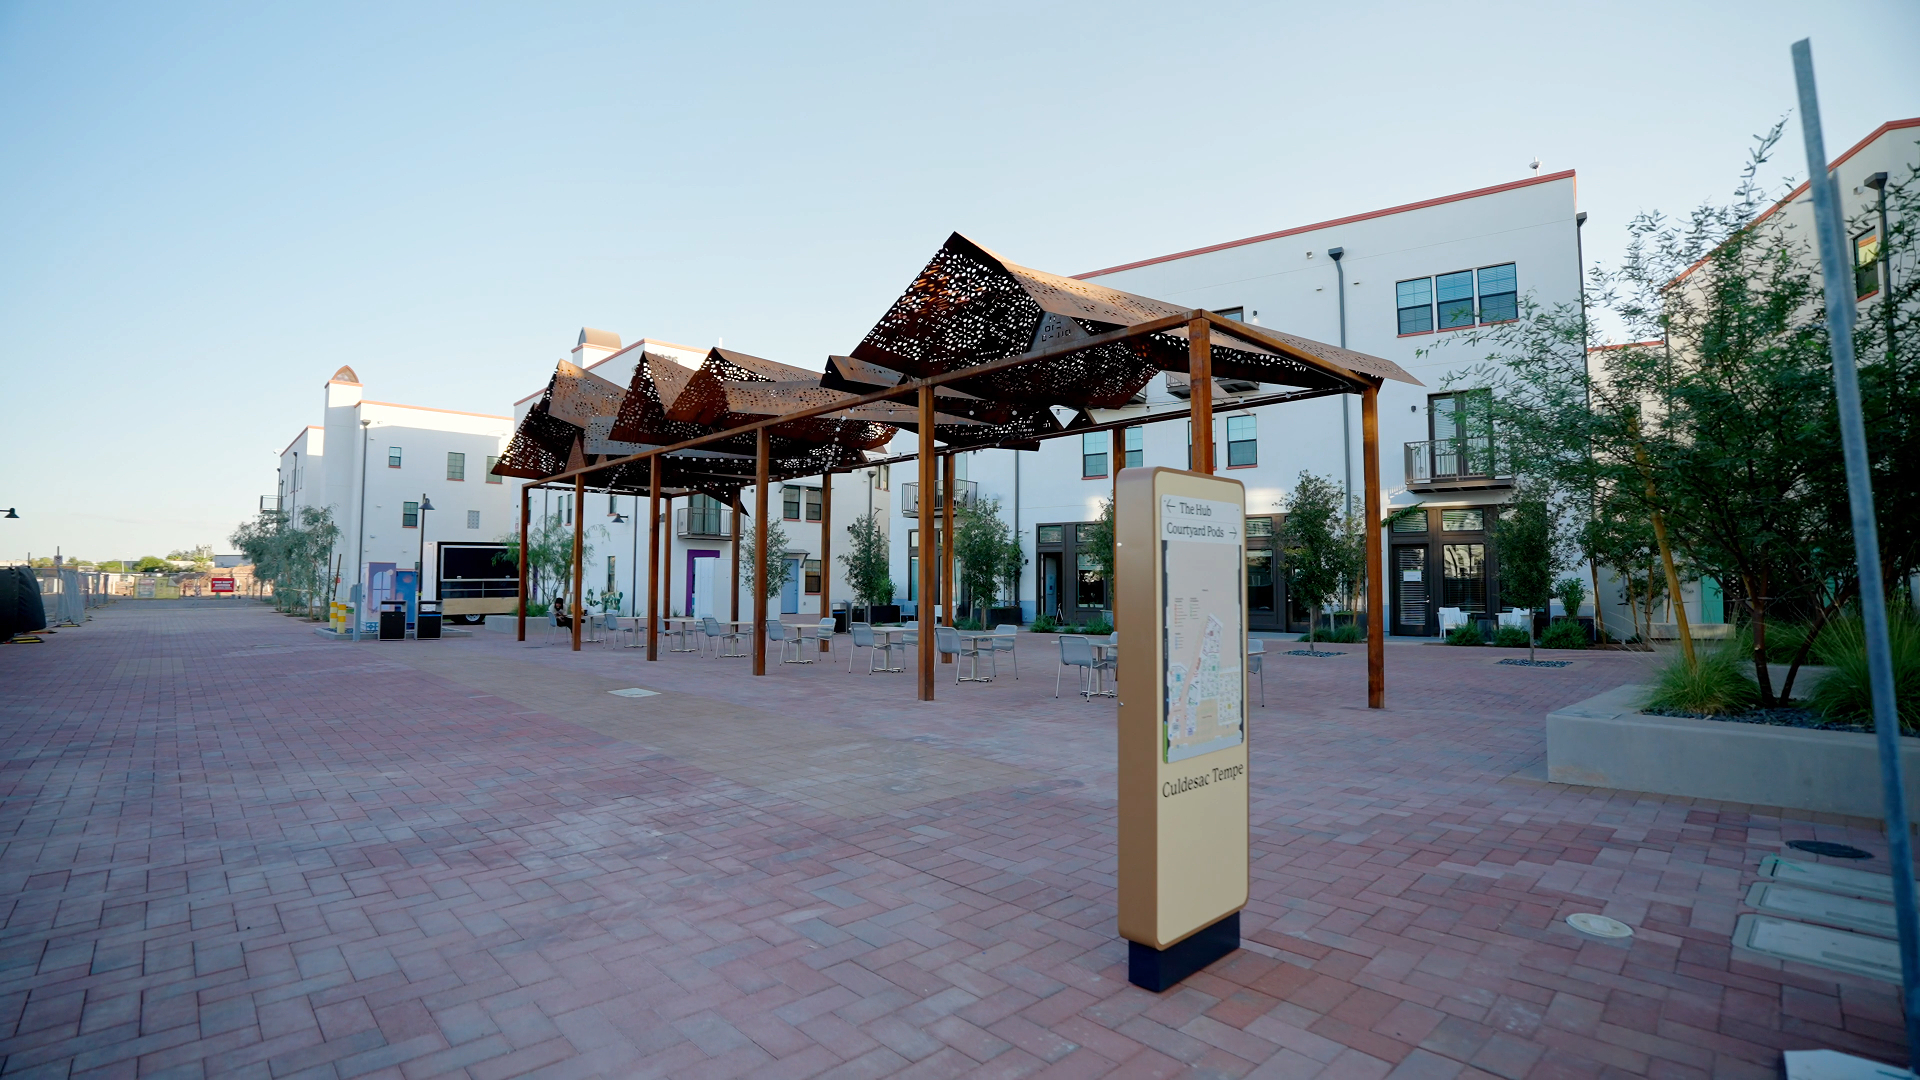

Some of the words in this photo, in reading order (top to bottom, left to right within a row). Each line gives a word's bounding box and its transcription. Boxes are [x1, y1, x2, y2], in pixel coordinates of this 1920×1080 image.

[1179, 502, 1195, 515] The
[1196, 504, 1212, 517] Hub
[1166, 522, 1206, 538] Courtyard
[1207, 525, 1225, 538] Pods
[1162, 774, 1210, 798] Culdesac
[1212, 763, 1244, 782] Tempe
